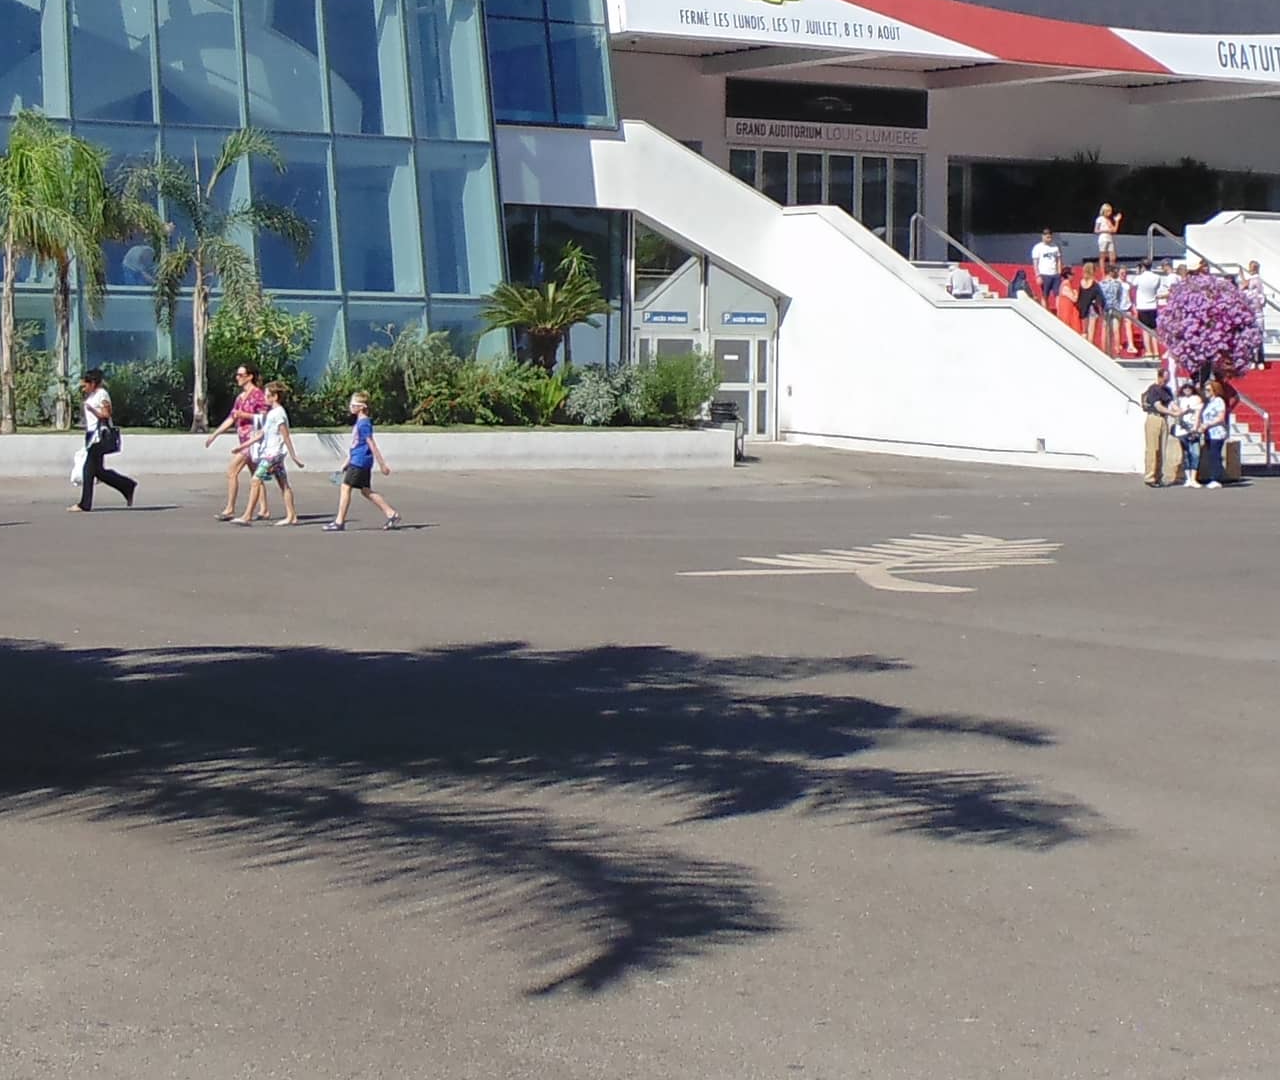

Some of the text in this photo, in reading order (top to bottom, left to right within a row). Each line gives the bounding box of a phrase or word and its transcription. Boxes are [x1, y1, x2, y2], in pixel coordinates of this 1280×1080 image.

[713, 11, 730, 28] LES
[733, 13, 769, 33] LUNDIS,
[772, 16, 788, 32] LES
[791, 18, 800, 33] 17
[805, 19, 842, 39] JUILLET,
[843, 22, 850, 37] 8
[853, 23, 864, 38] ET
[867, 24, 874, 39] 9
[735, 121, 767, 137] GRAND
[770, 124, 822, 139] AUDITORIUM
[826, 126, 862, 141] LOUIS
